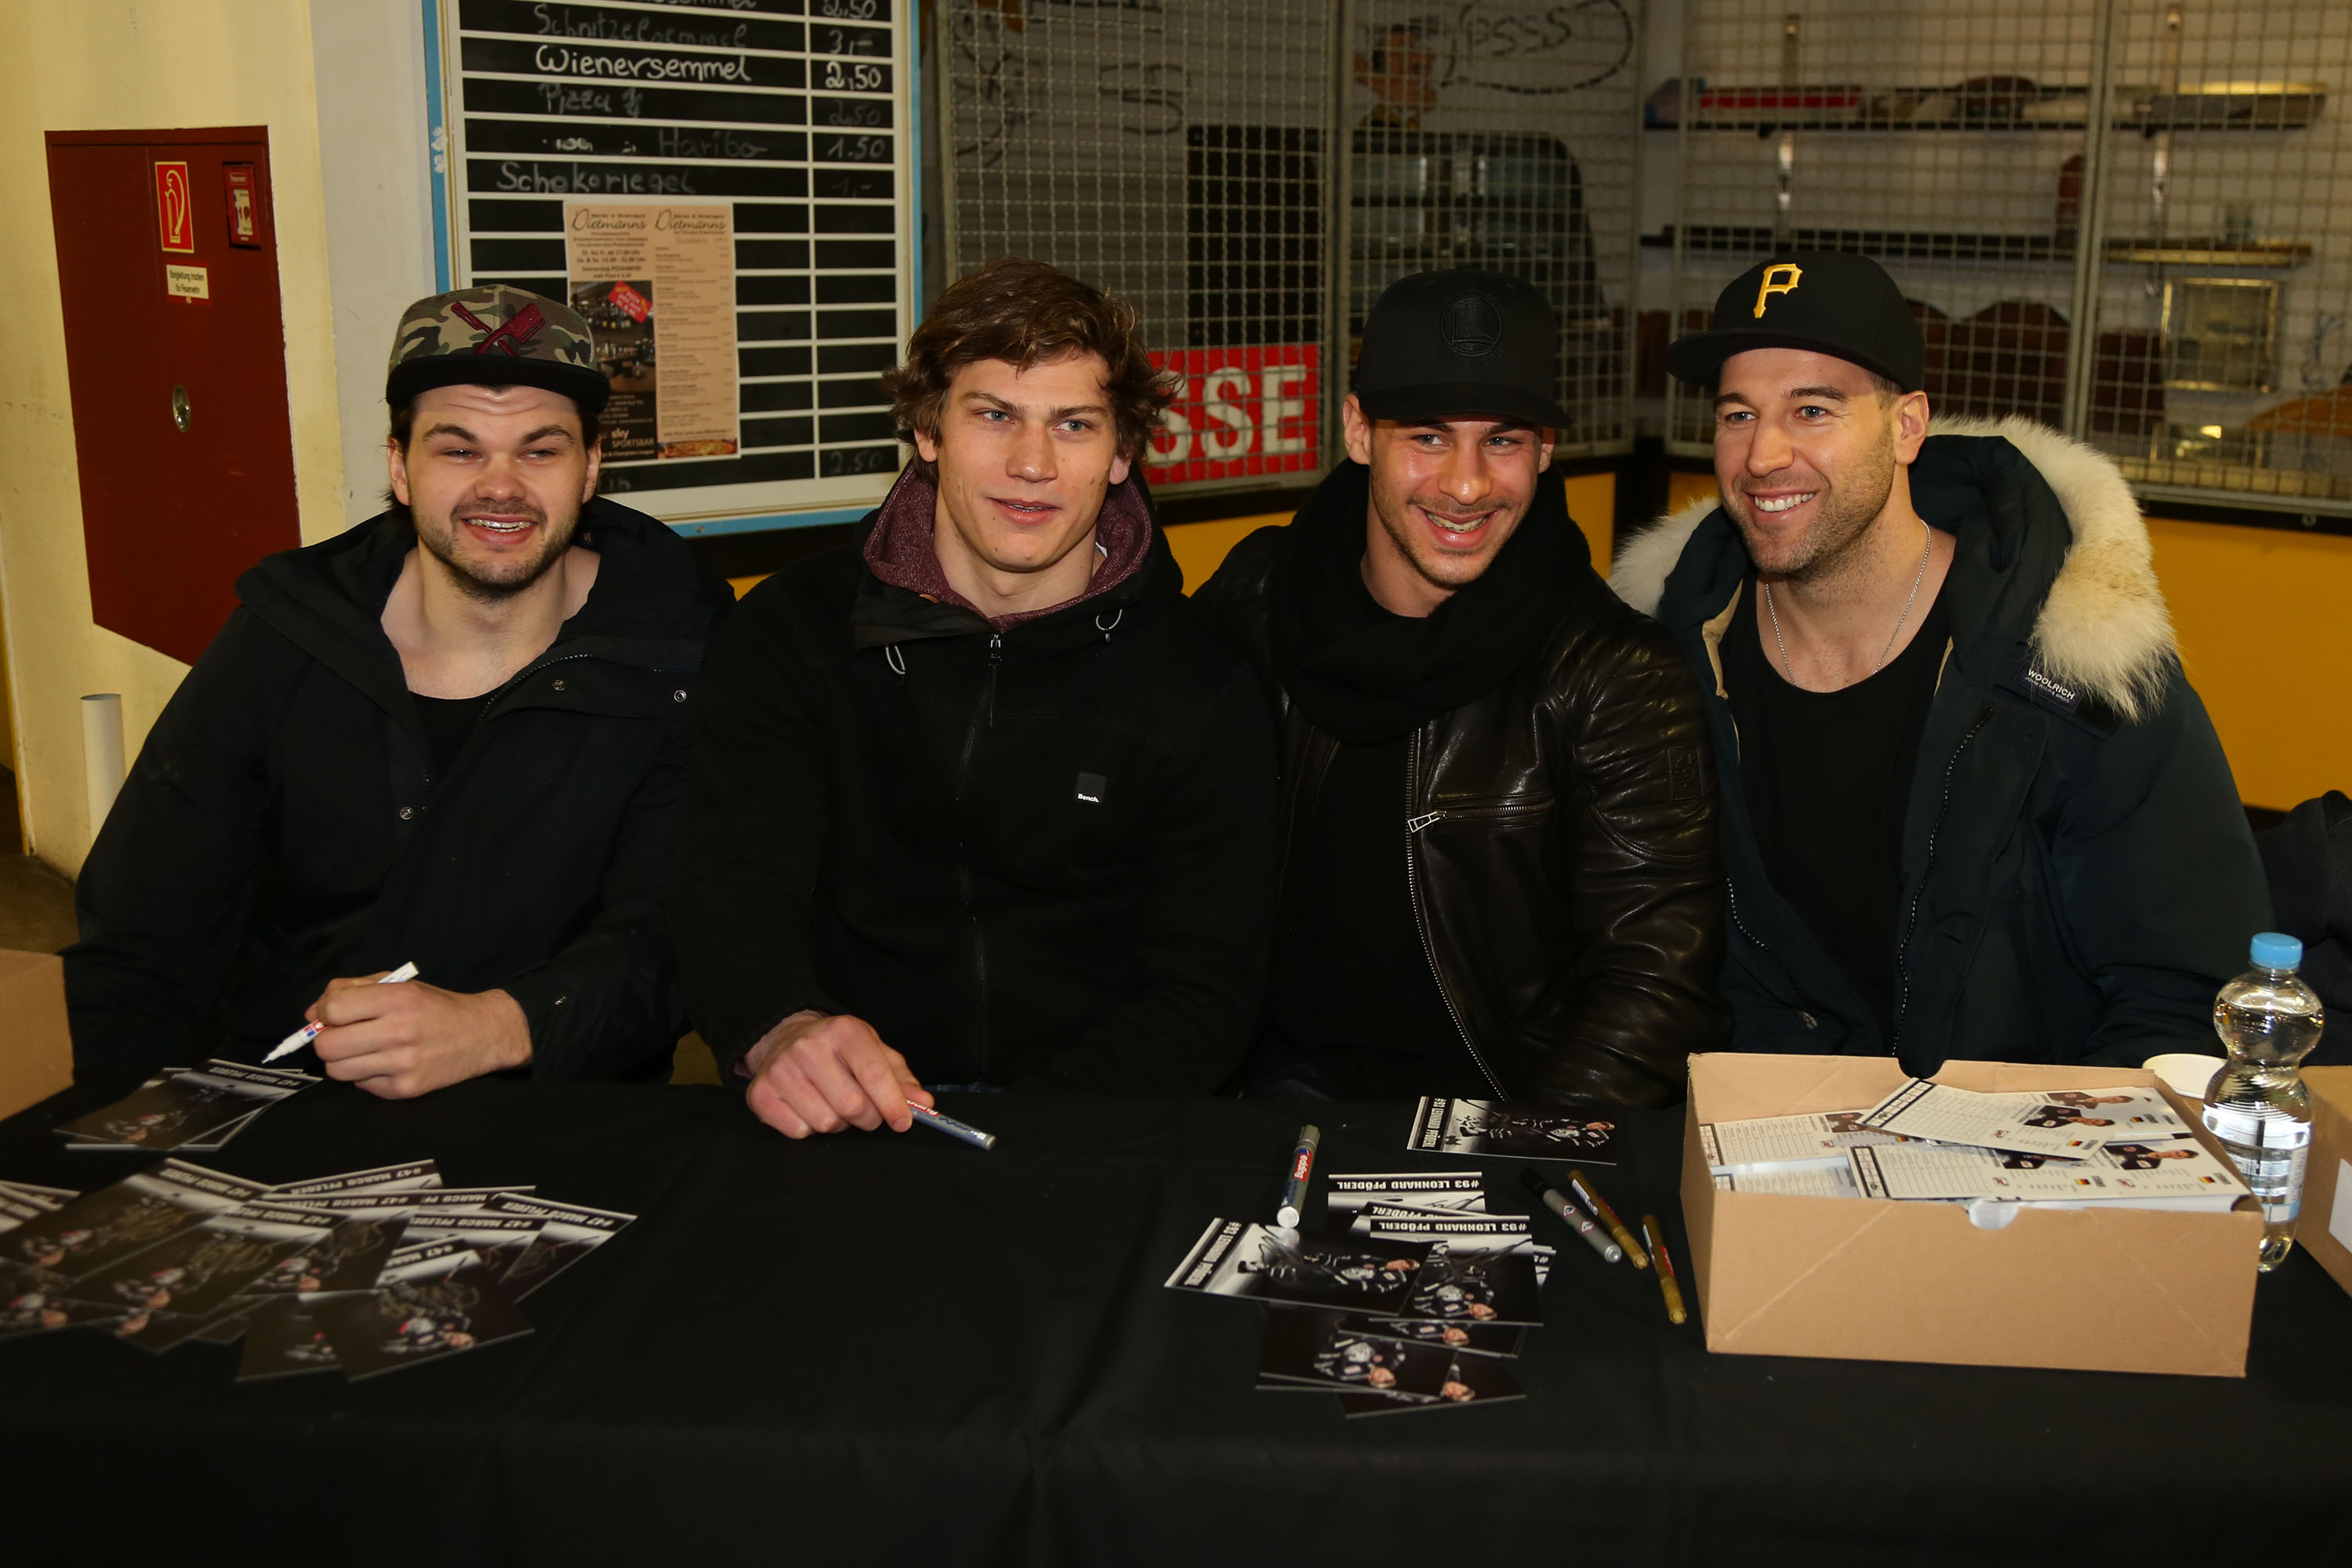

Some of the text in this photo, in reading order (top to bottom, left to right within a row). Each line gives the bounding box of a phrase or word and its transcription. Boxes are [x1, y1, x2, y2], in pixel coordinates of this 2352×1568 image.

[535, 44, 882, 91] Wienersemmel 2,50
[827, 136, 885, 160] 1.50
[496, 161, 696, 194] Schokoriegel
[1754, 263, 1803, 318] P
[2027, 669, 2076, 700] WOOLRICH
[347, 1172, 392, 1186] MARCO
[1337, 1180, 1479, 1191] #93 LEONHARD PFÖDERL
[1379, 1221, 1527, 1232] #93 LEONHARD PFÖDERL
